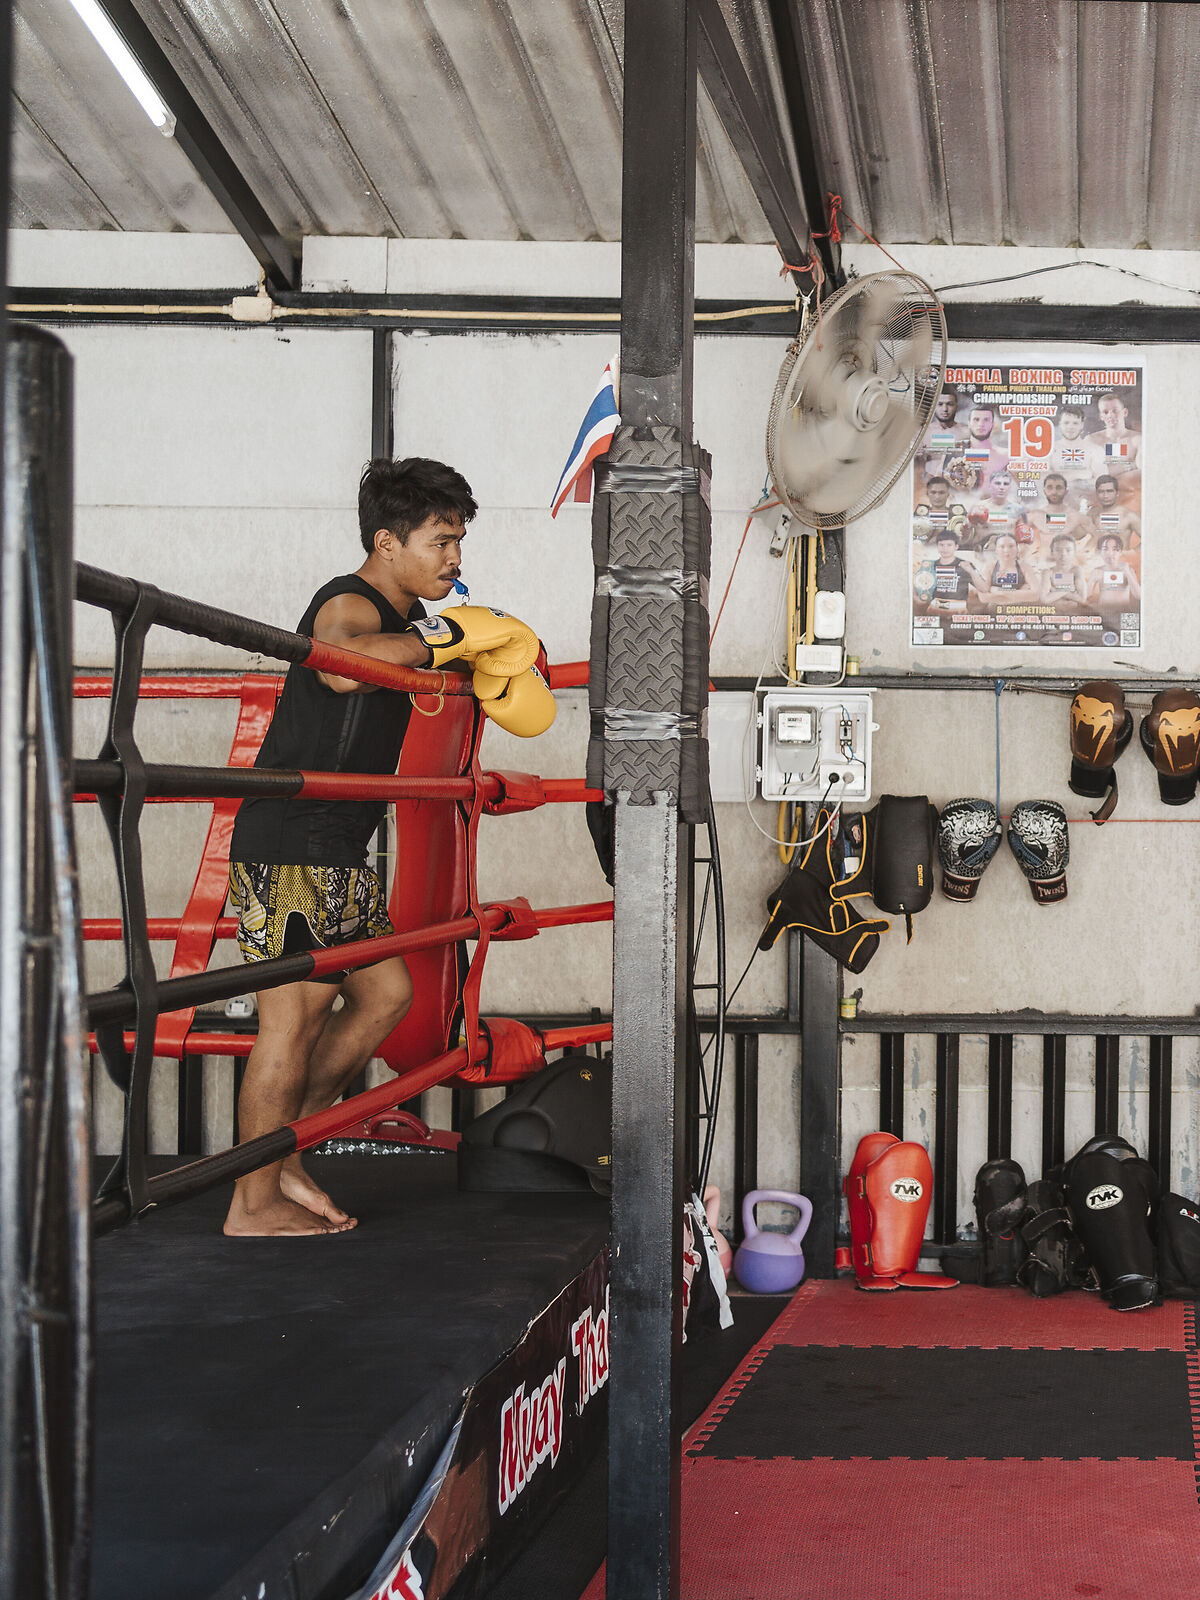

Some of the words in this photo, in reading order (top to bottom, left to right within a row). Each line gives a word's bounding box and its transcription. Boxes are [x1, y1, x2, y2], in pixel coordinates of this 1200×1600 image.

[945, 369, 1001, 385] BANGLA
[1010, 370, 1063, 385] BOXING
[1071, 370, 1136, 385] STADIUM
[974, 394, 1056, 404] CHAMPIONSHIP
[1062, 394, 1093, 405] FIGHT
[1000, 406, 1057, 416] WEDNESDAY
[1004, 417, 1053, 458] 19
[1030, 462, 1048, 470] 2024
[1018, 471, 1024, 479] 9
[1026, 471, 1041, 479] PM
[271, 864, 279, 882] WINS
[944, 878, 970, 895] TWINS
[1038, 884, 1065, 898] TWINS
[266, 936, 274, 958] SPECI
[893, 1183, 920, 1197] TVK
[1090, 1188, 1120, 1206] TVK
[499, 1356, 567, 1516] Muay
[572, 1283, 609, 1415] Tha
